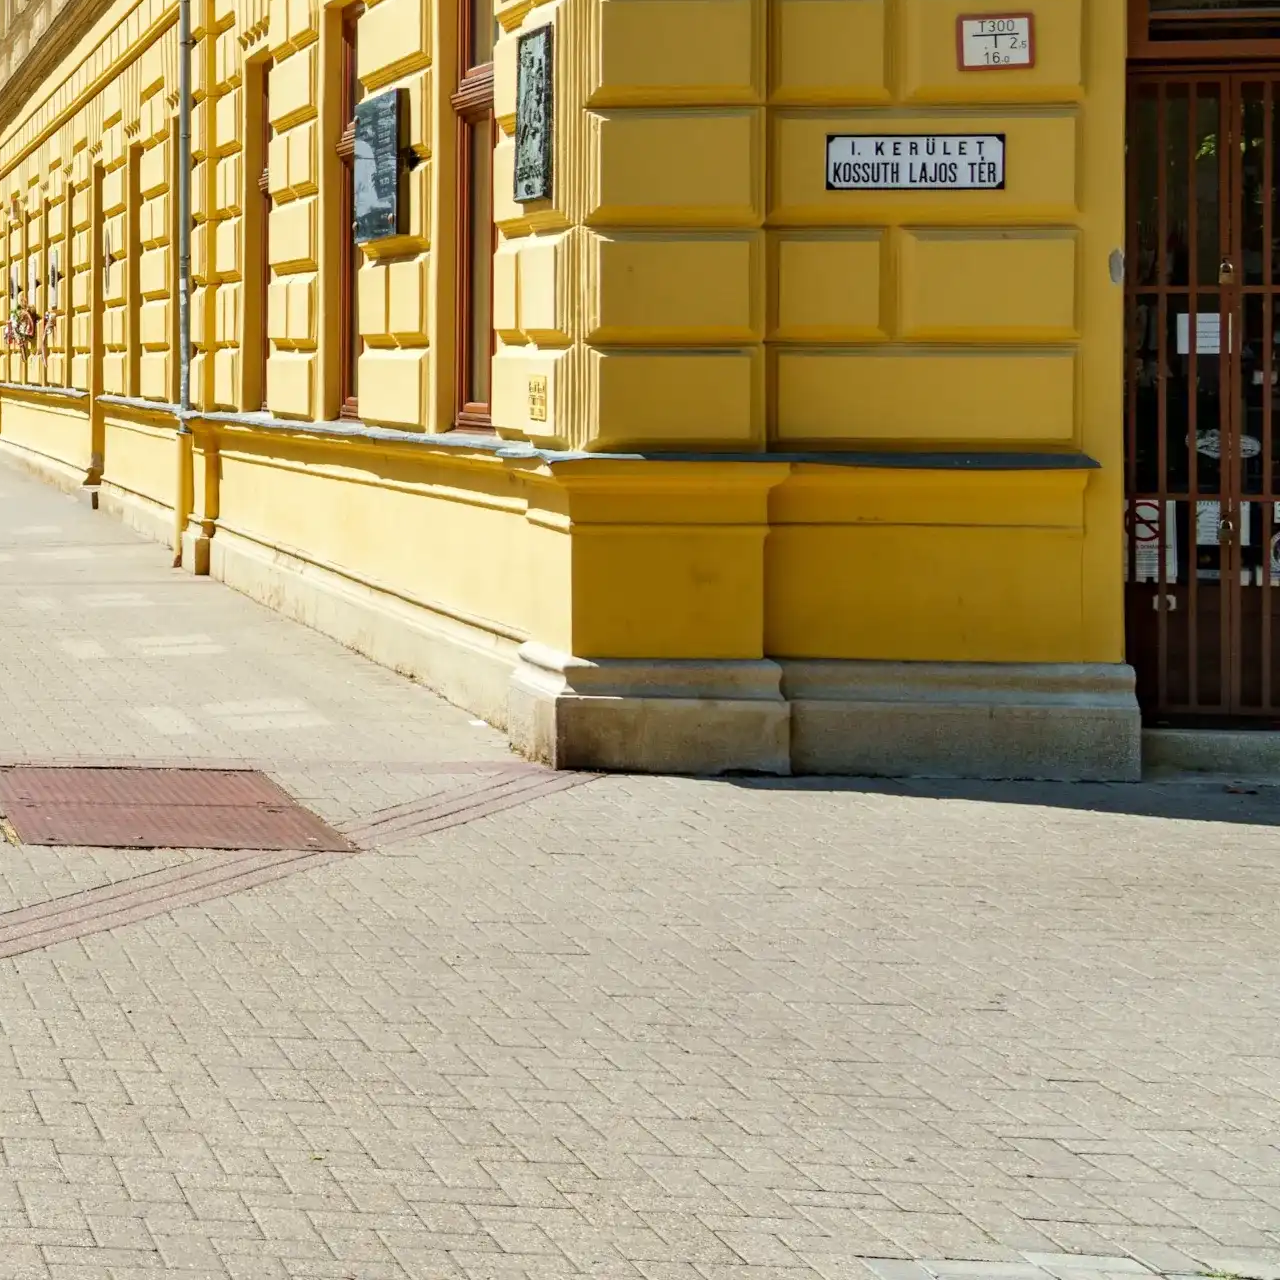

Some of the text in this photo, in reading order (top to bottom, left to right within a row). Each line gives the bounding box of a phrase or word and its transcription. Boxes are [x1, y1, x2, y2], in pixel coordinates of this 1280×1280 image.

[978, 19, 1015, 32] T300
[851, 138, 985, 156] I. KERÜLET
[833, 156, 997, 183] KOSSUTH LAJOS TÉR
